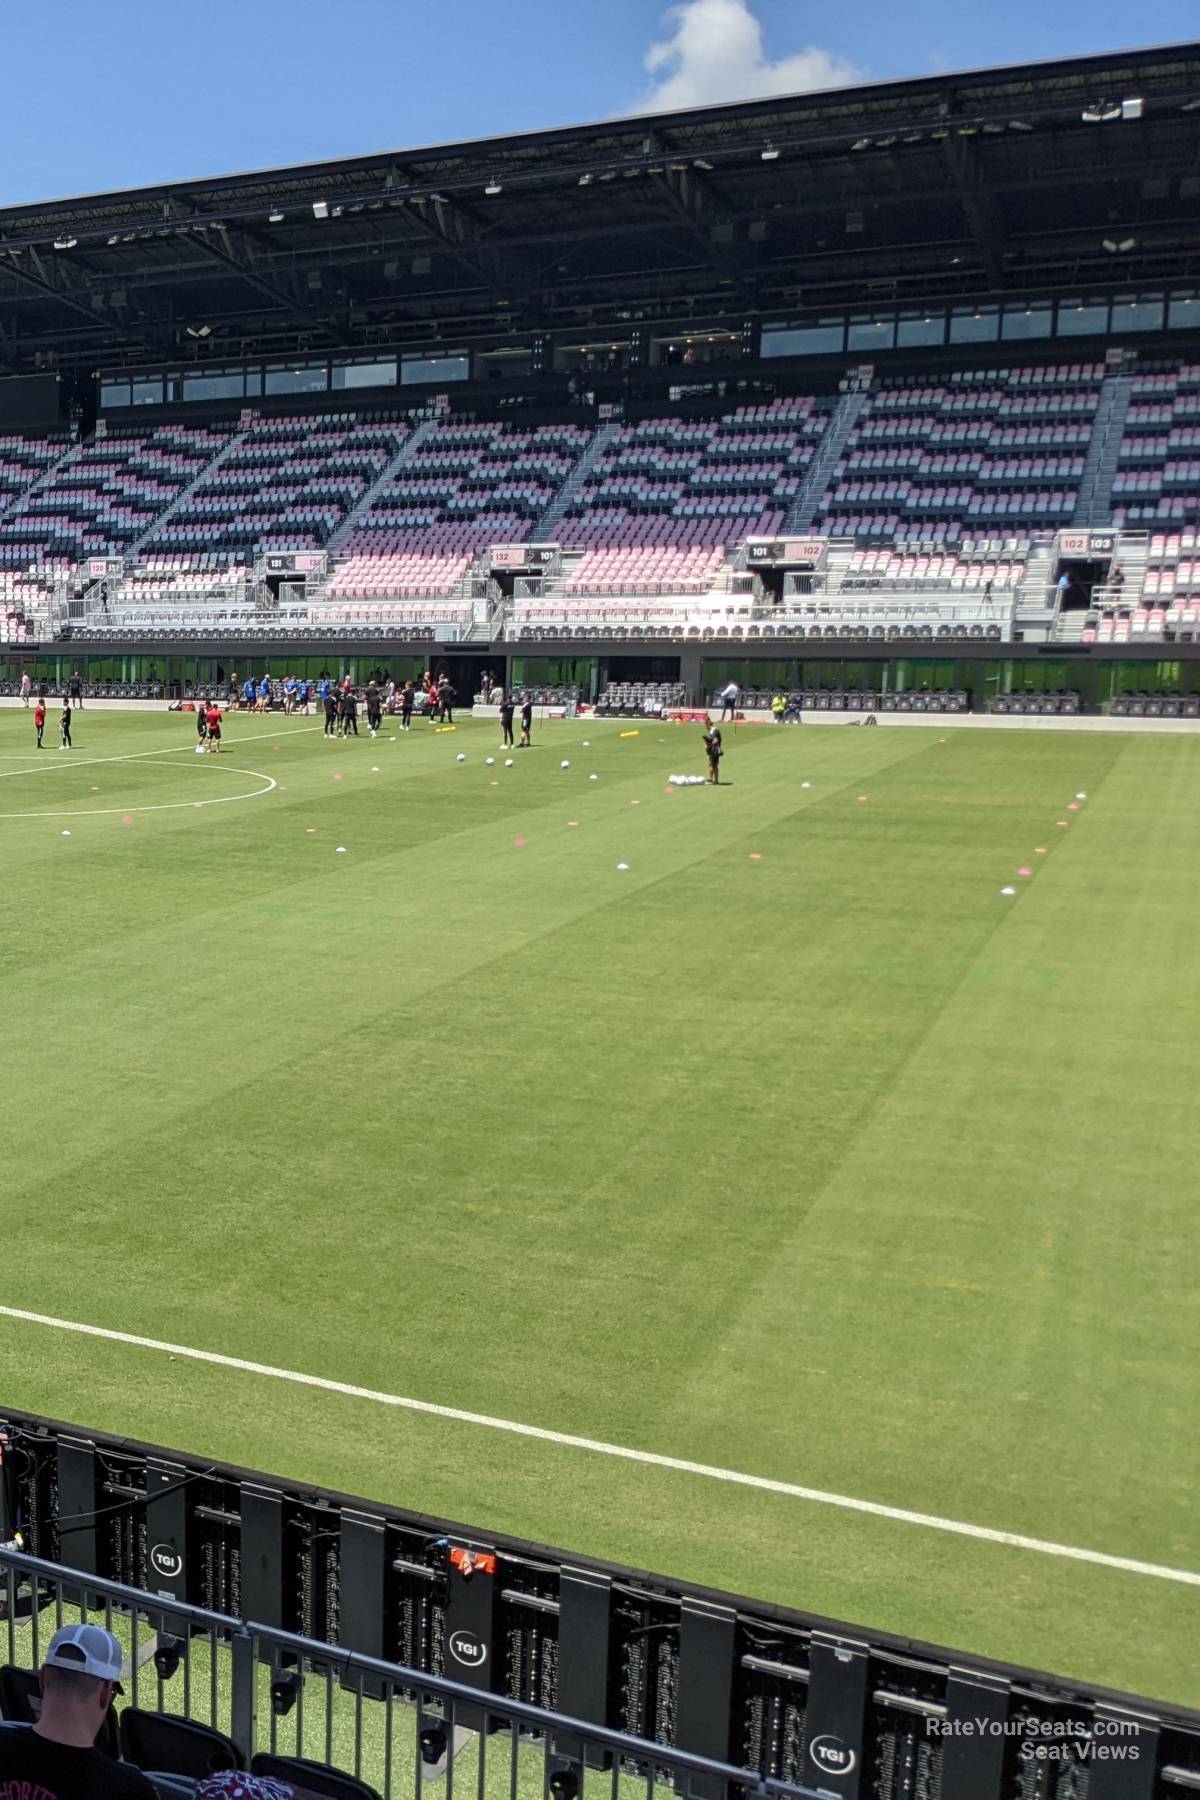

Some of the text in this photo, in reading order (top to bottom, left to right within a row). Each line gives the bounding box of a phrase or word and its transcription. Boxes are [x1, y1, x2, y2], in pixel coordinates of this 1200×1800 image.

[1064, 539, 1111, 549] 102 103
[495, 552, 553, 561] 132 101
[753, 546, 820, 556] 101 102
[156, 1553, 175, 1568] TGI
[455, 1641, 478, 1656] TGI
[818, 1746, 845, 1764] TGI
